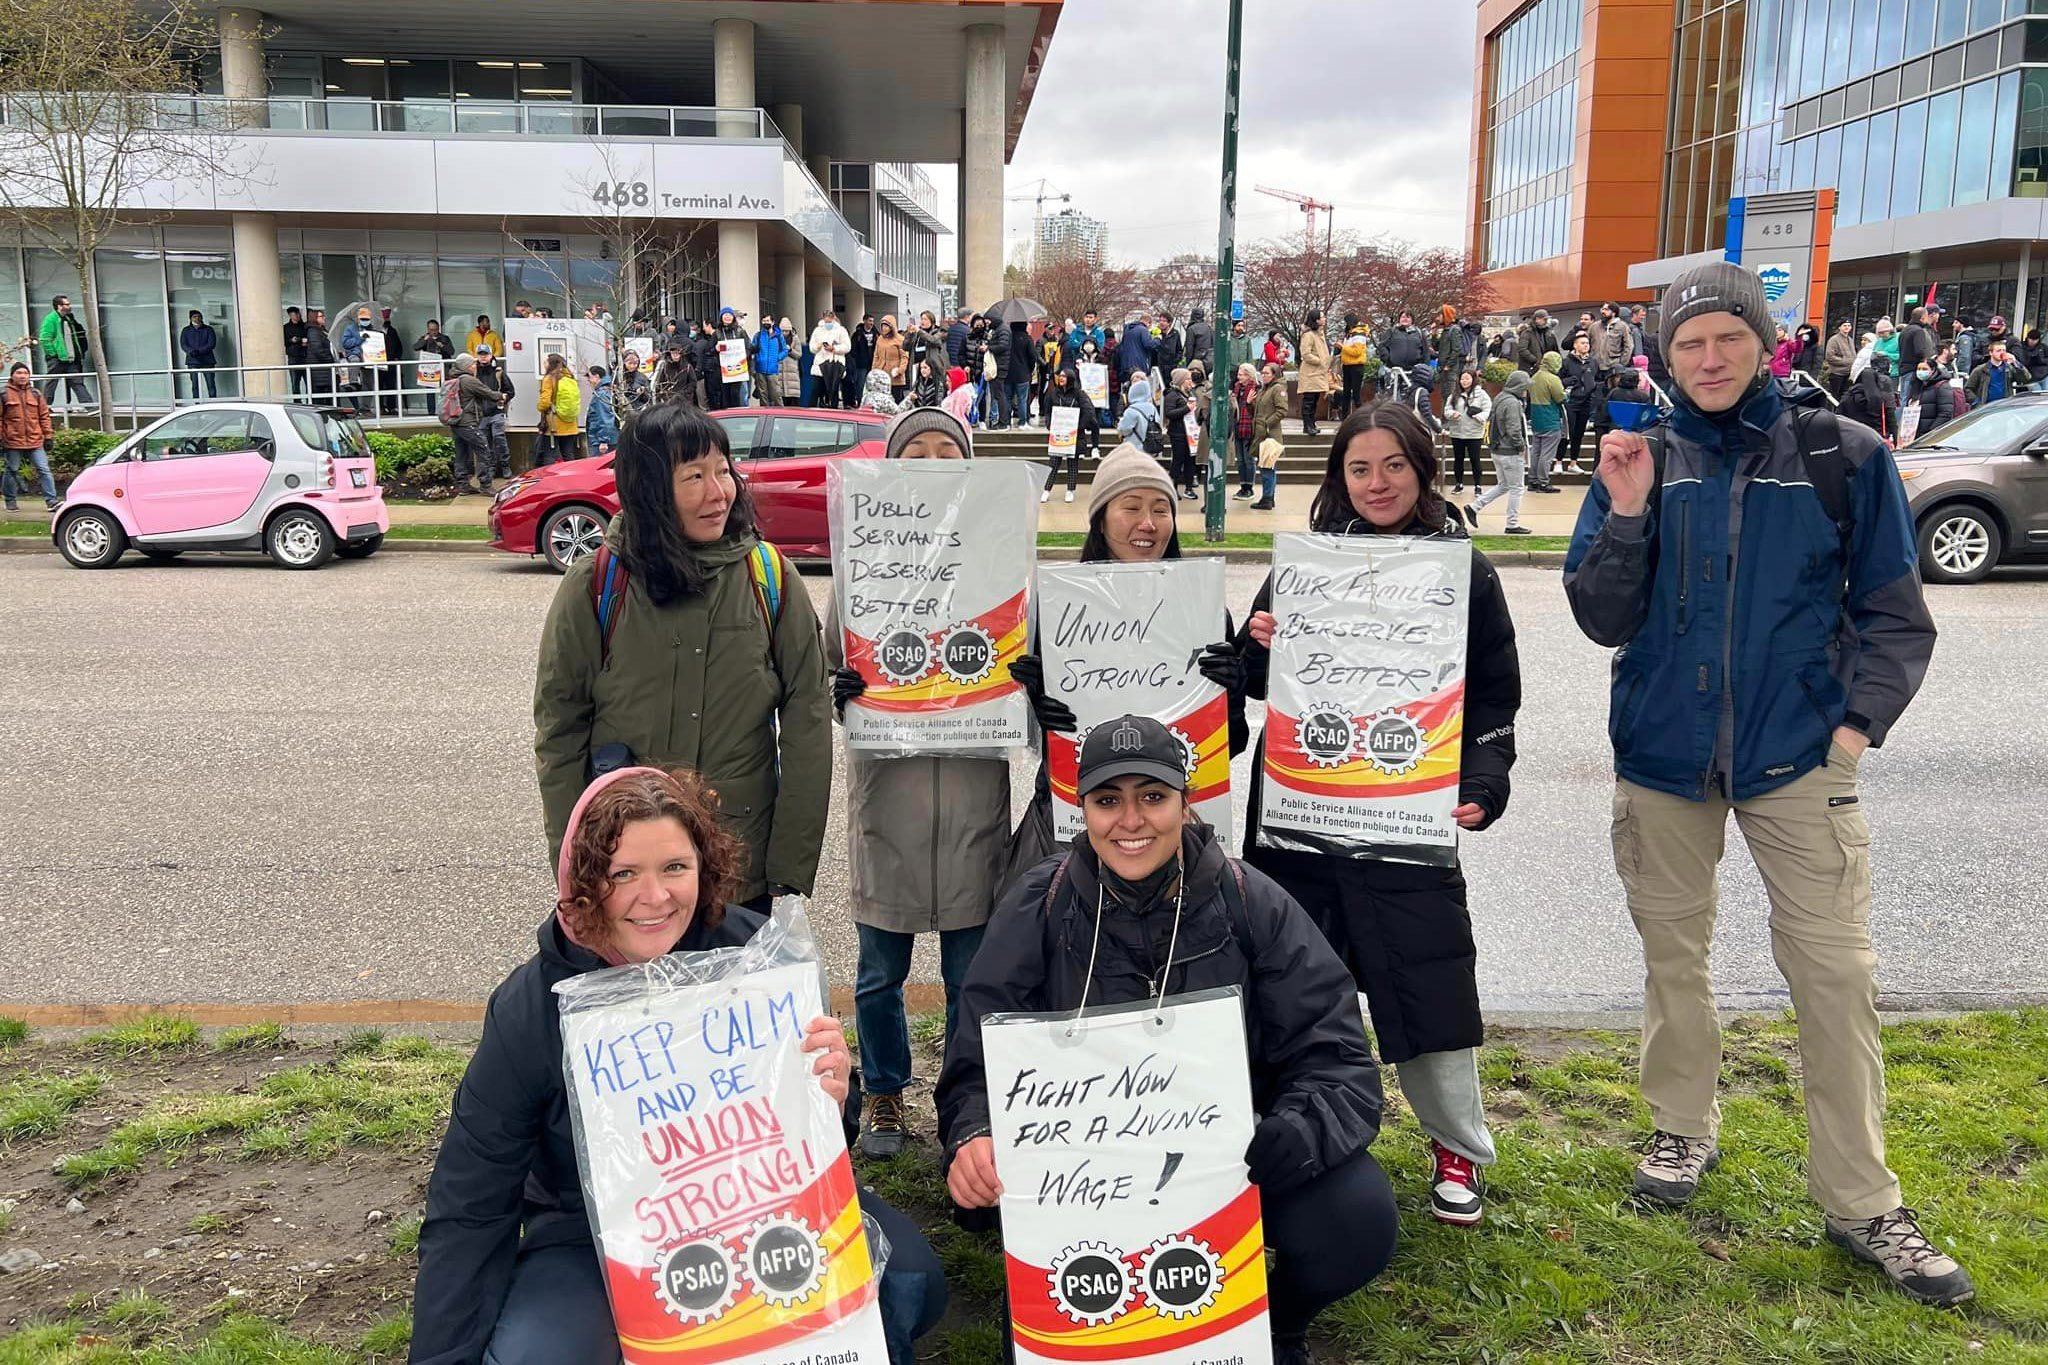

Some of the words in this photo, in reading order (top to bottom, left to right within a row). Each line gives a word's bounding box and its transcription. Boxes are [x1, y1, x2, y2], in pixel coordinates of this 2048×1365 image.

[593, 181, 649, 207] 468
[661, 193, 732, 209] Terminal
[737, 195, 775, 209] Ave.
[1762, 224, 1793, 235] 438
[546, 323, 567, 332] 468
[850, 493, 931, 521] PUBLIC
[849, 526, 962, 549] SERVANTS
[850, 559, 962, 583] DESERVE
[1275, 565, 1333, 600] OUR
[850, 588, 955, 619] BETTER!
[1054, 598, 1164, 648] UNION
[886, 645, 924, 662] PSAC
[948, 645, 986, 662] AFPC
[1060, 648, 1205, 693] STRONG!
[1296, 652, 1457, 692] BETTER!
[849, 732, 881, 741] Alliance
[944, 730, 978, 742] publique
[980, 730, 990, 740] du
[992, 730, 1022, 739] Canada
[863, 718, 890, 729] Public
[893, 718, 926, 729] Service
[928, 718, 962, 728] Alliance
[965, 718, 973, 727] of
[976, 717, 1007, 727] Canada
[1307, 726, 1347, 746] PSAC
[1373, 732, 1415, 752] AFPC
[1476, 731, 1497, 745] new
[1266, 810, 1298, 822] Alliance
[1300, 814, 1310, 823] de
[1313, 815, 1321, 824] la
[1324, 816, 1360, 829] Fonction
[1362, 822, 1400, 834] publique
[1402, 825, 1414, 834] du
[1416, 826, 1449, 838] Canada
[1281, 798, 1308, 810] Public
[1311, 801, 1344, 814] Service
[1347, 806, 1384, 818] Alliance
[1386, 810, 1396, 819] of
[1398, 811, 1433, 823] Canada
[583, 1021, 677, 1097] KEEP
[702, 991, 803, 1057] CALM
[637, 1082, 696, 1126] AND
[710, 1064, 755, 1102] BE
[1004, 1068, 1105, 1112] FIGHT
[1107, 1052, 1178, 1099] NOW
[642, 1096, 782, 1166] UNION
[1013, 1119, 1072, 1148] FOR
[1084, 1115, 1109, 1143] A
[1116, 1103, 1222, 1138] LIVING
[635, 1139, 816, 1243] STRONG!
[670, 1260, 725, 1295] PSAC
[759, 1243, 811, 1277] AFPC
[1065, 1272, 1119, 1297] PSAC
[1154, 1264, 1208, 1291] AFPC
